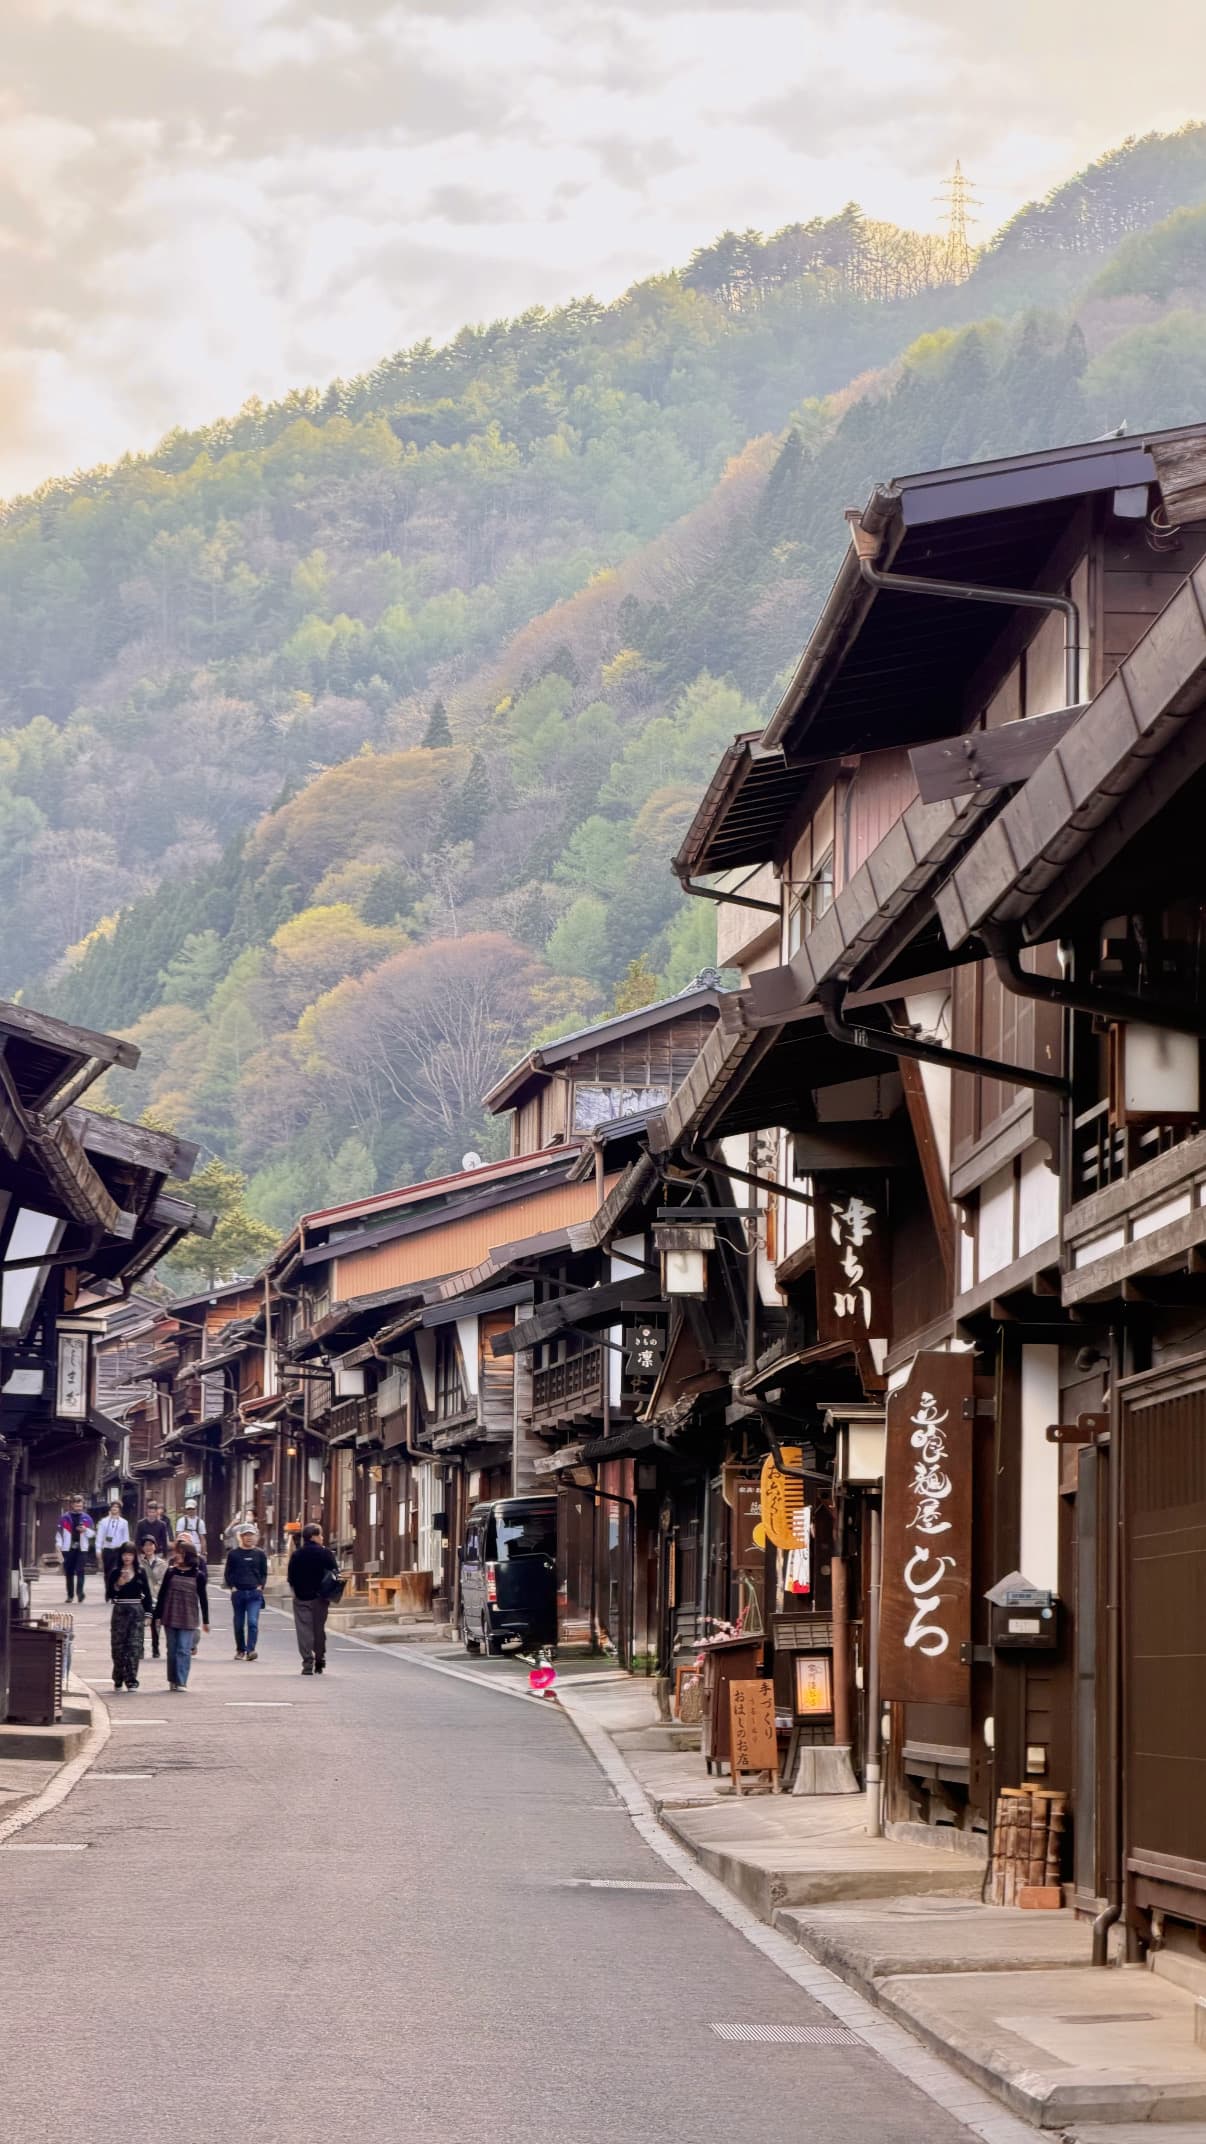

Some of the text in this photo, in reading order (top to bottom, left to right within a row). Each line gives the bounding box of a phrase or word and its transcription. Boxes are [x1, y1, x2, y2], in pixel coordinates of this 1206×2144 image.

[903, 1546, 957, 1657] ひろ
[734, 1690, 750, 1766] おはしのお店
[759, 1682, 773, 1740] 手づくり
